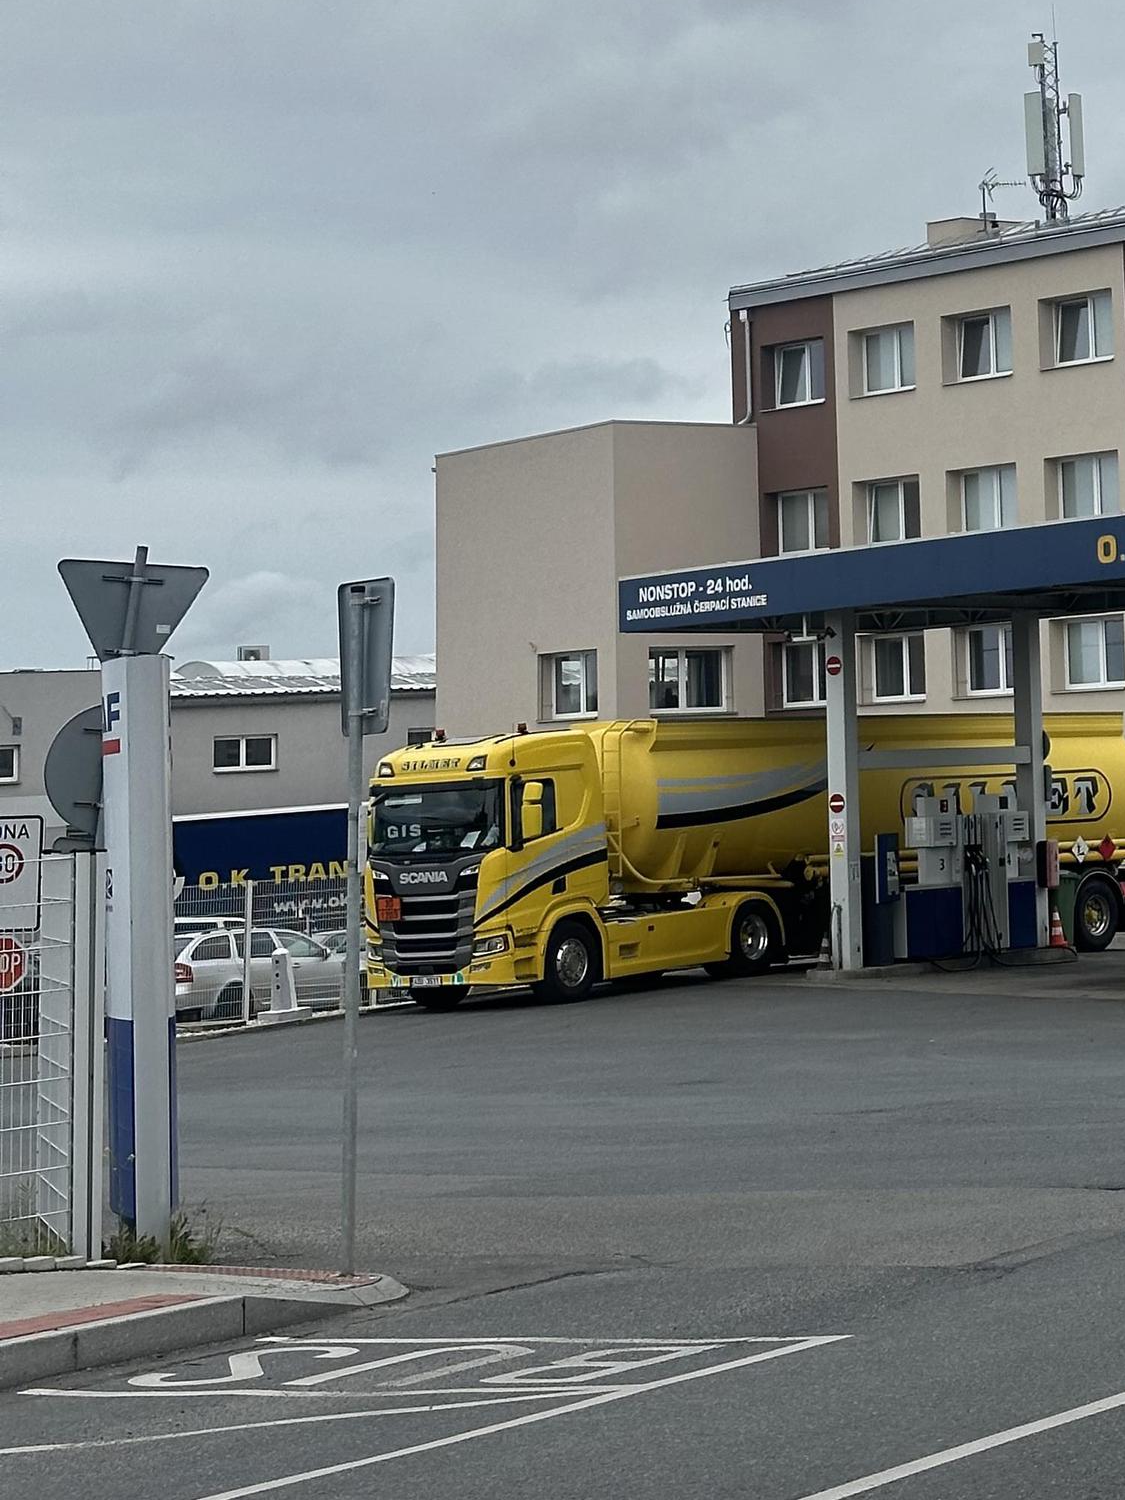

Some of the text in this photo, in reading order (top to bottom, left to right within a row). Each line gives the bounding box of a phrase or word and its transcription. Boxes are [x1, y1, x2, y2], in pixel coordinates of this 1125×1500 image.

[639, 581, 696, 603] NONSTOP
[706, 578, 723, 595] 24
[726, 574, 752, 593] hod.
[693, 596, 730, 614] ČERPACÍ
[730, 594, 768, 610] STANICE
[103, 691, 120, 732] F
[0, 823, 30, 840] NA
[387, 824, 422, 839] GIS
[0, 854, 16, 874] 0
[270, 861, 349, 885] TRAN
[939, 858, 945, 871] 3
[400, 871, 448, 884] SCANIA
[128, 1344, 726, 1387] BUS
